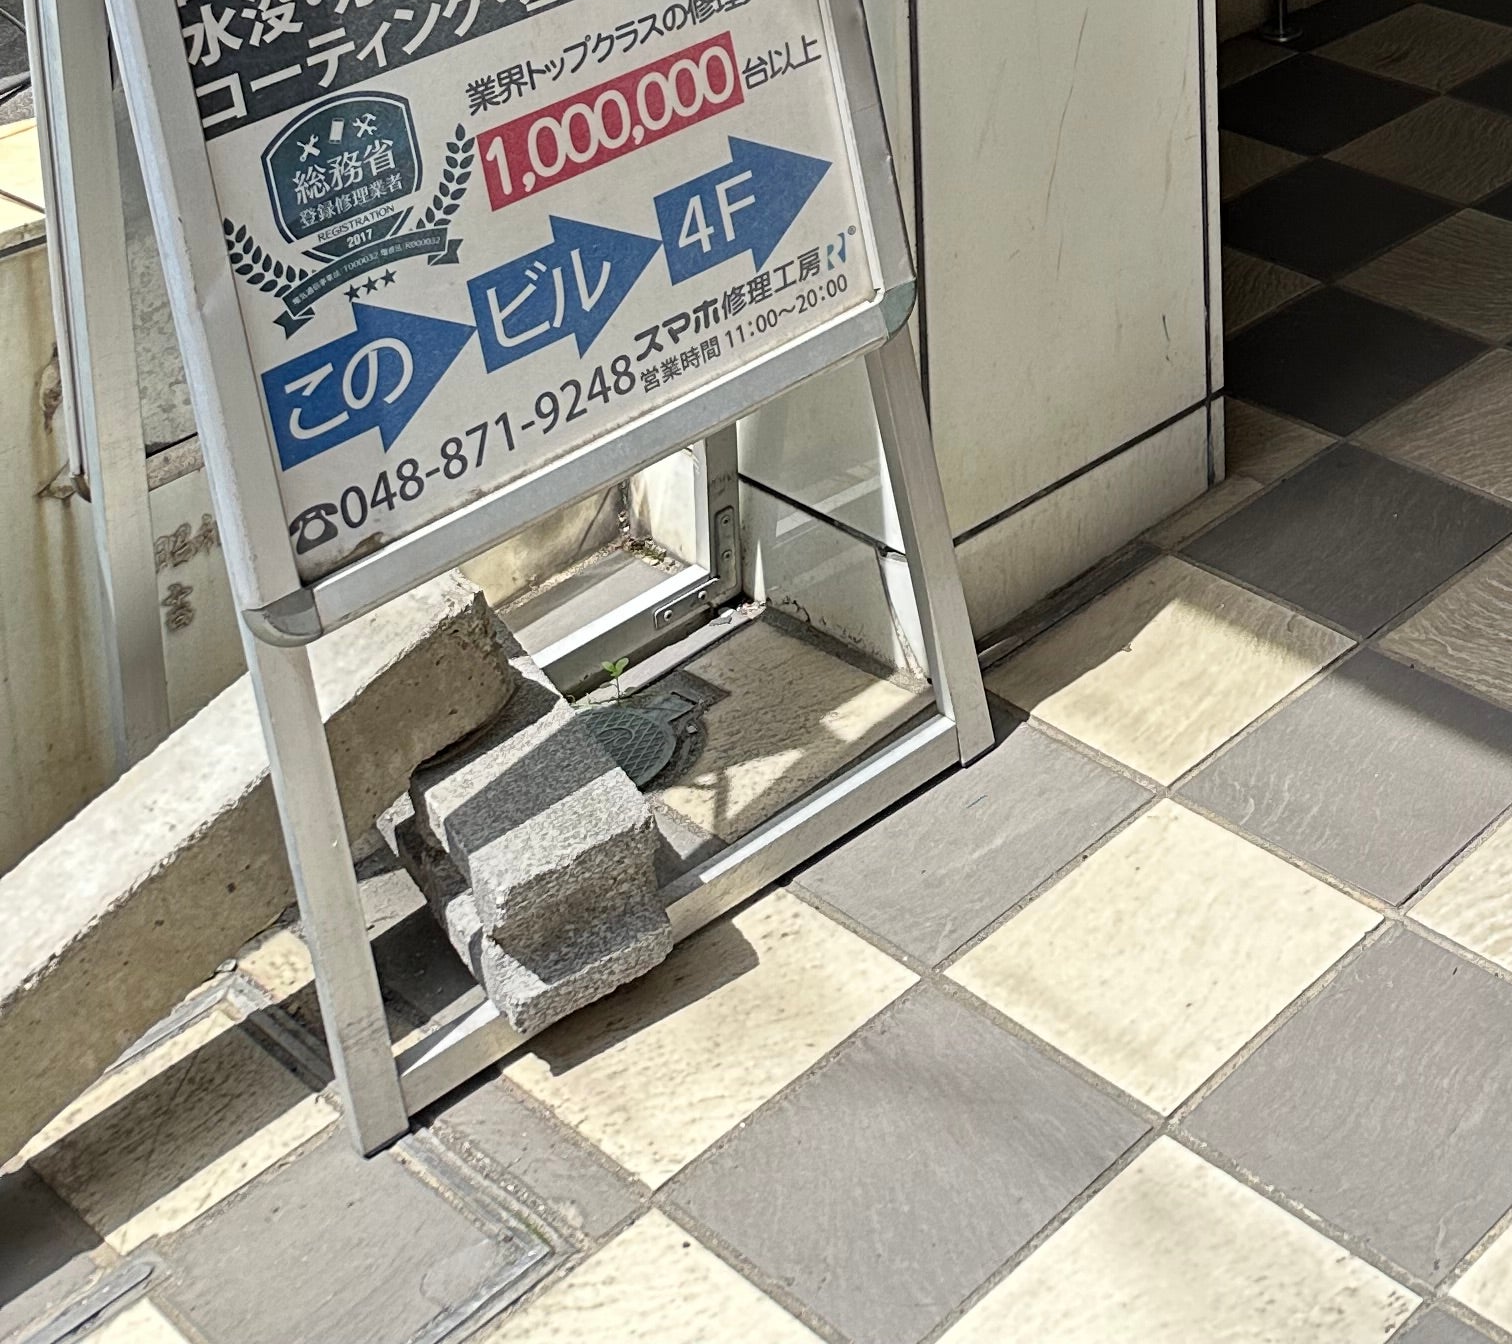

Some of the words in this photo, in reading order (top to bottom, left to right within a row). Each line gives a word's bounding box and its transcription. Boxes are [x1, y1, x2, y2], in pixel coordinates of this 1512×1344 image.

[486, 46, 735, 195] 1,000,000
[741, 36, 821, 91] 台以上
[293, 139, 396, 205] 総務省
[299, 173, 403, 229] 登録修理業者
[317, 204, 395, 243] REGISTRATION
[346, 228, 374, 249] 2017
[284, 334, 414, 441] この
[485, 245, 611, 348] ビル
[673, 167, 757, 257] 4F
[634, 246, 821, 362] スマホ修理工房
[640, 335, 721, 394] 営業時間
[339, 355, 637, 531] 048-871-9248
